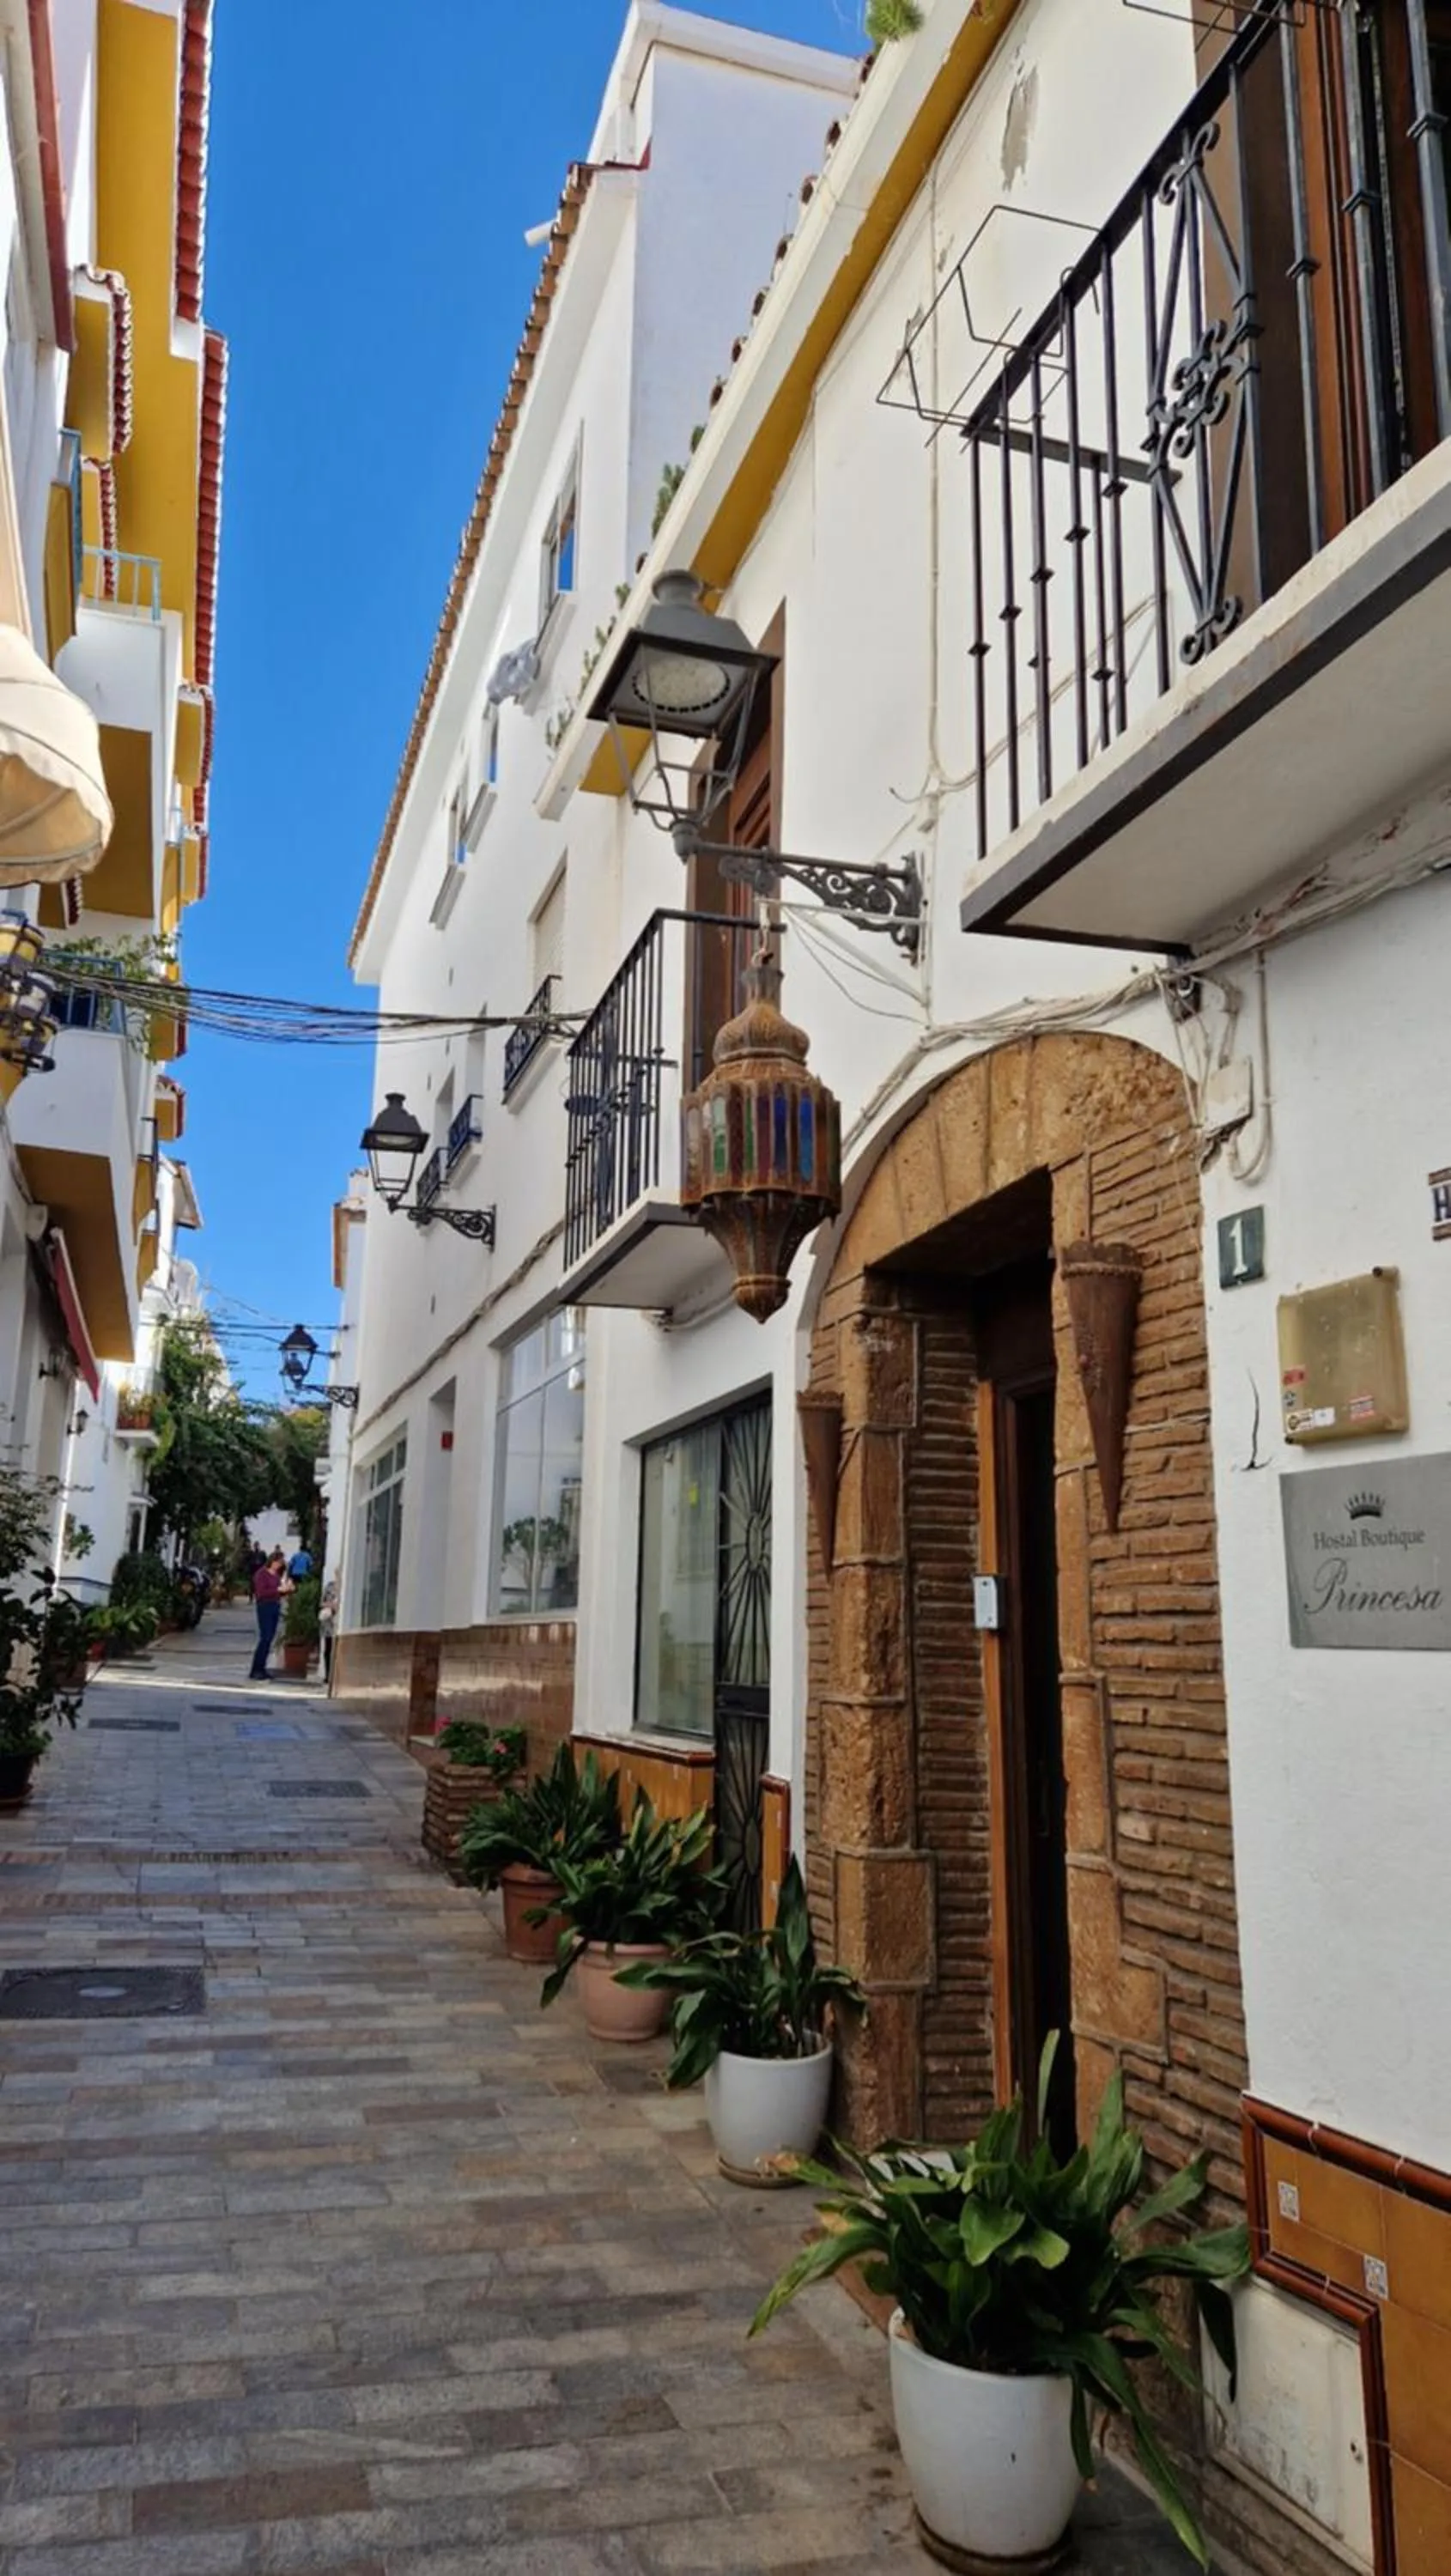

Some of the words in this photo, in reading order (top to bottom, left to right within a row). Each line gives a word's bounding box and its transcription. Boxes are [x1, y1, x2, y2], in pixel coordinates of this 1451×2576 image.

[1229, 1218, 1248, 1276] 1
[1313, 1529, 1357, 1550] Hostal
[1360, 1528, 1426, 1551] Boutique
[1303, 1557, 1443, 1614] Princesa
